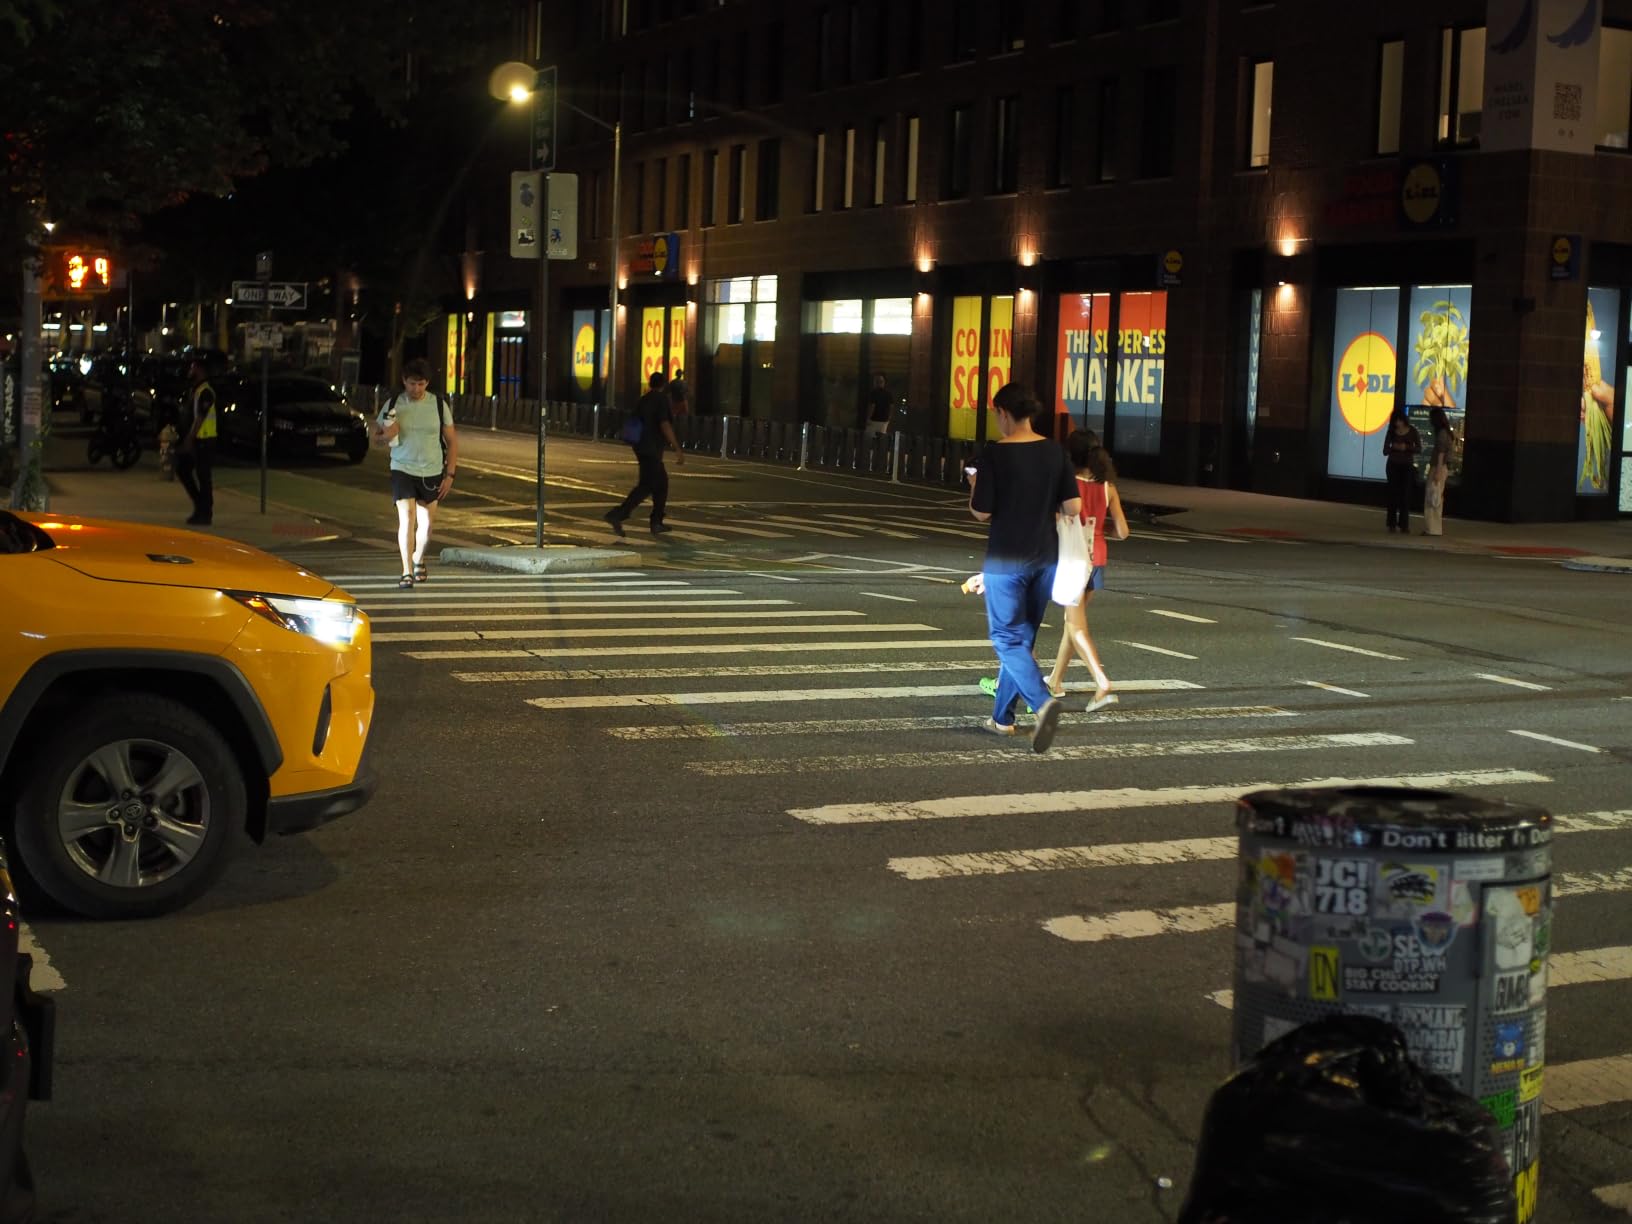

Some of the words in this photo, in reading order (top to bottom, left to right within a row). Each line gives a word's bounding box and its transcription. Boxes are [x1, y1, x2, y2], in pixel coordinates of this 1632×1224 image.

[243, 288, 264, 301] ONE
[273, 288, 298, 301] WAY
[955, 328, 1012, 357] COIN
[1065, 328, 1089, 354] THE
[1094, 328, 1166, 354] SPERES
[952, 364, 1011, 410] SOO
[1382, 830, 1448, 849] Don't
[1455, 830, 1505, 849] litter
[1316, 886, 1368, 915] 718
[1345, 979, 1377, 991] STAY
[1379, 979, 1436, 991] COOKIN
